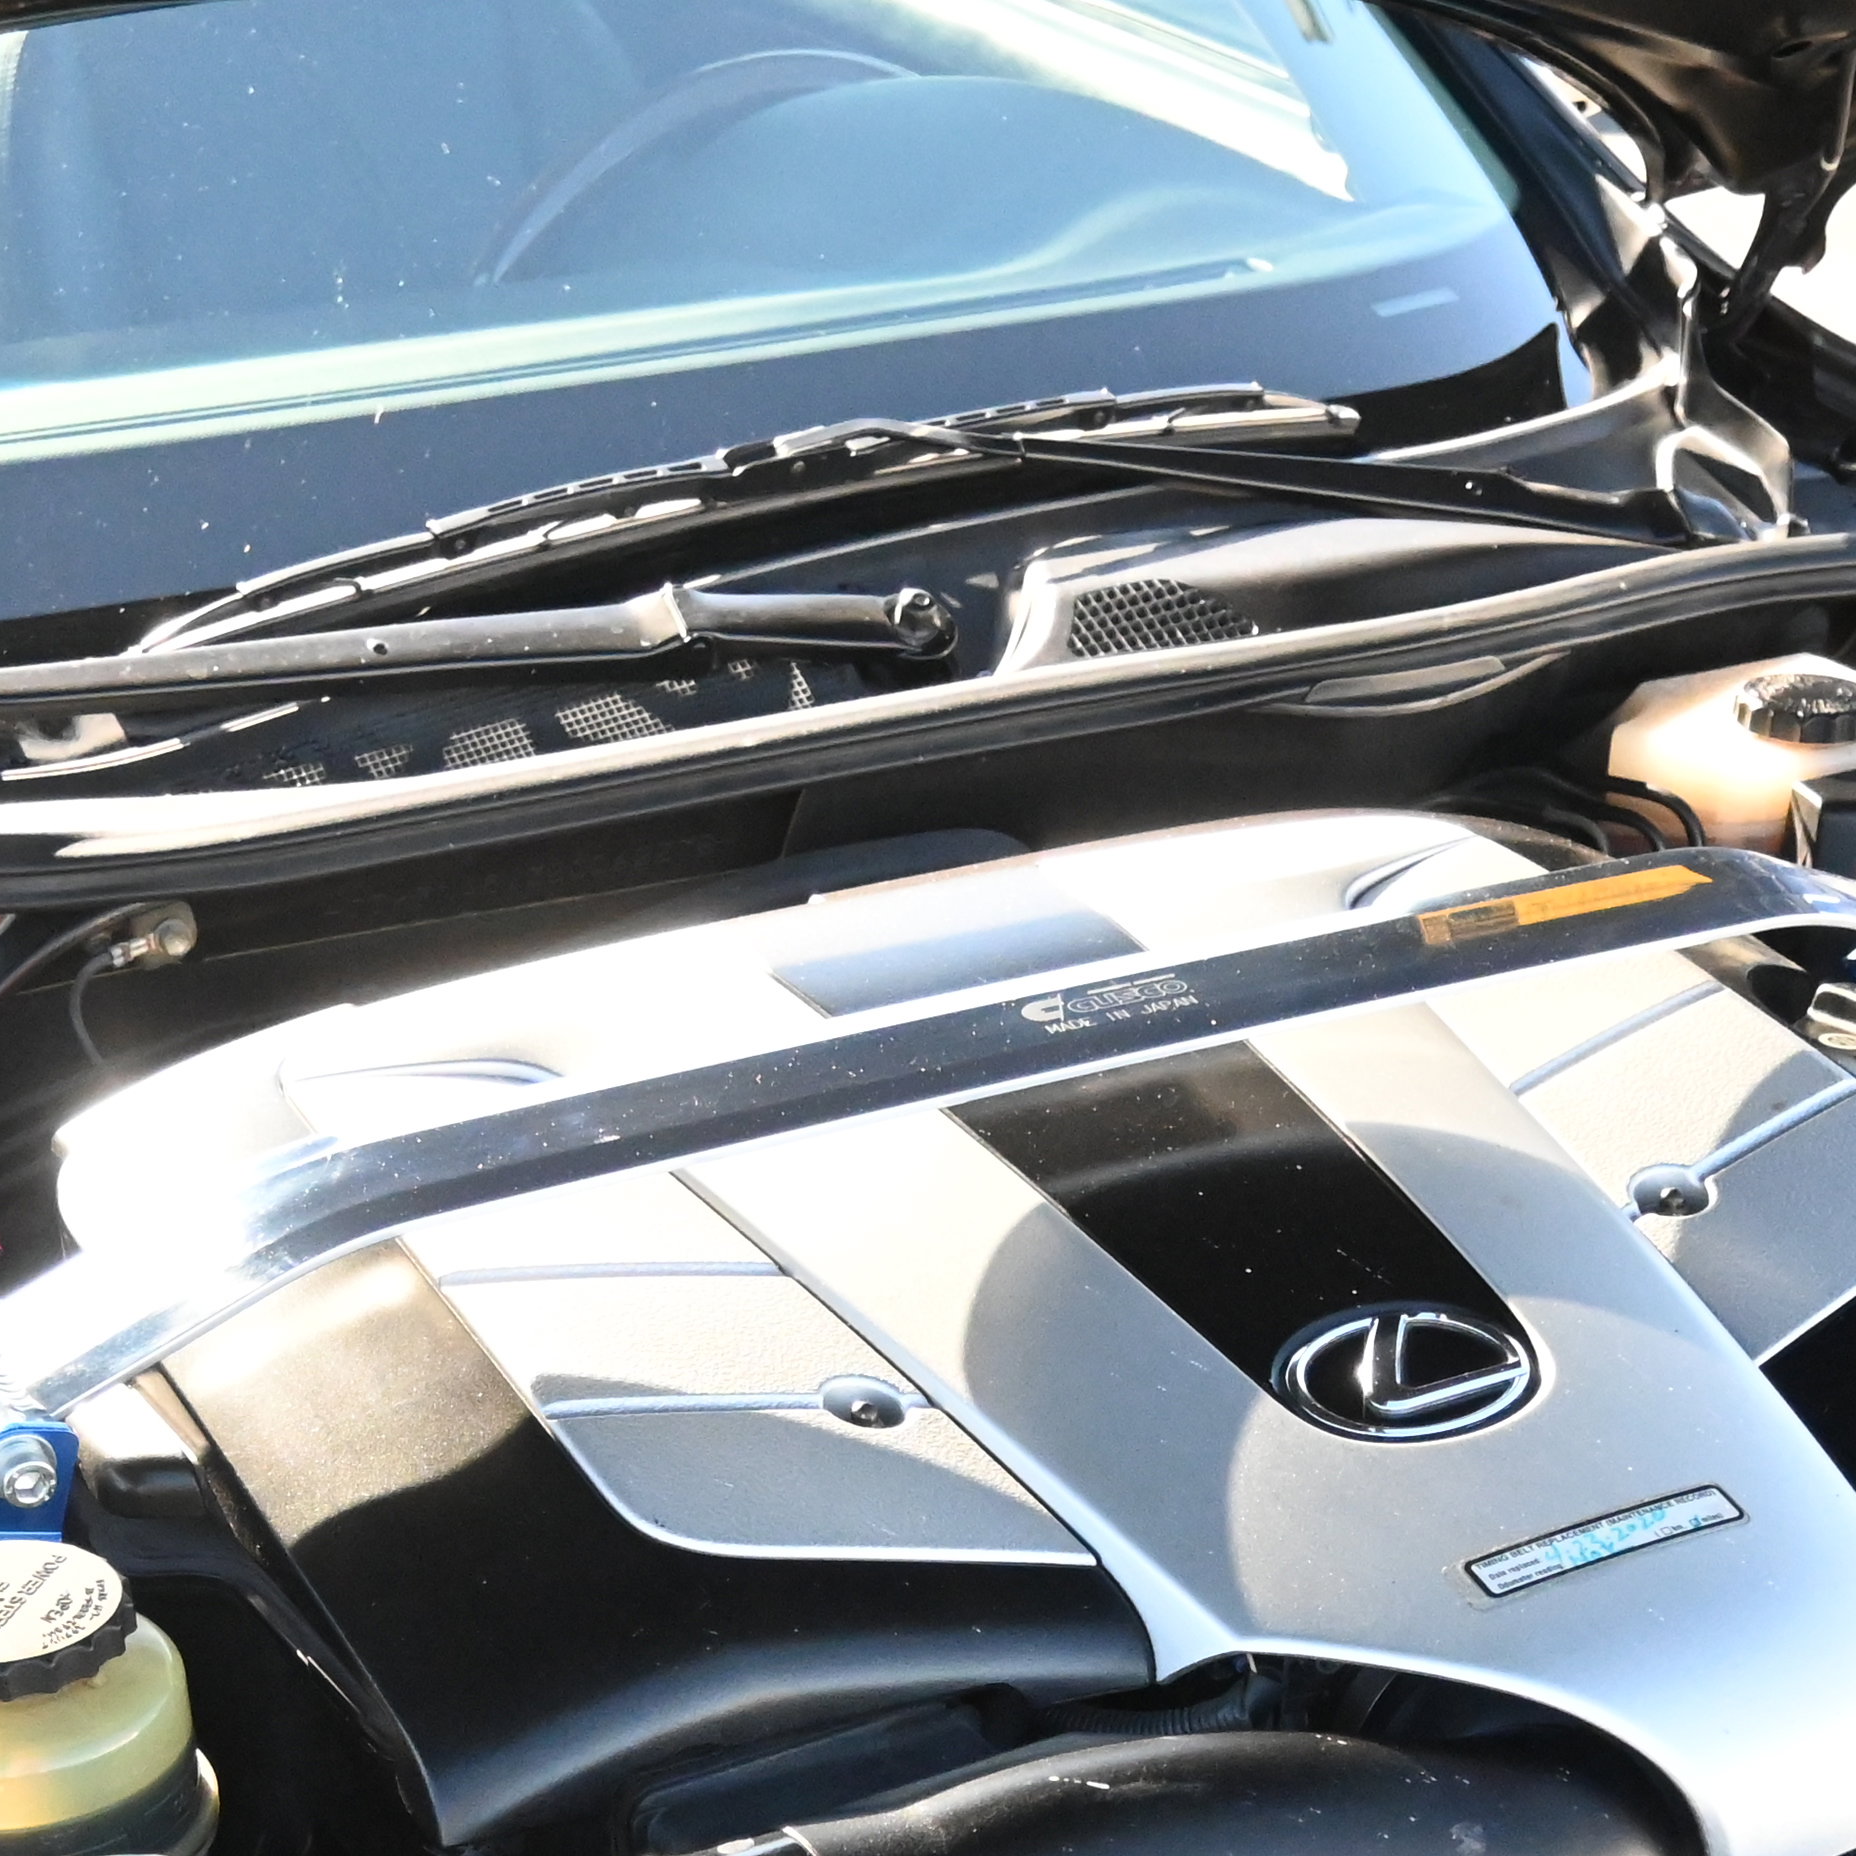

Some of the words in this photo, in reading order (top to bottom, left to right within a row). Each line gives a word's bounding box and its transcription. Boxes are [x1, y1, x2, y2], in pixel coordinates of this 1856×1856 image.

[1044, 1018, 1097, 1034] MADE
[1106, 1009, 1131, 1022] IN
[1141, 994, 1199, 1015] JAPAN
[1067, 979, 1188, 1013] CUSCO
[1474, 1554, 1510, 1571] TIMING
[1510, 1545, 1535, 1559] BELT
[1536, 1521, 1605, 1549] REPLACEMENT
[16, 1554, 68, 1596] POWER
[40, 1597, 73, 1624] OPEN
